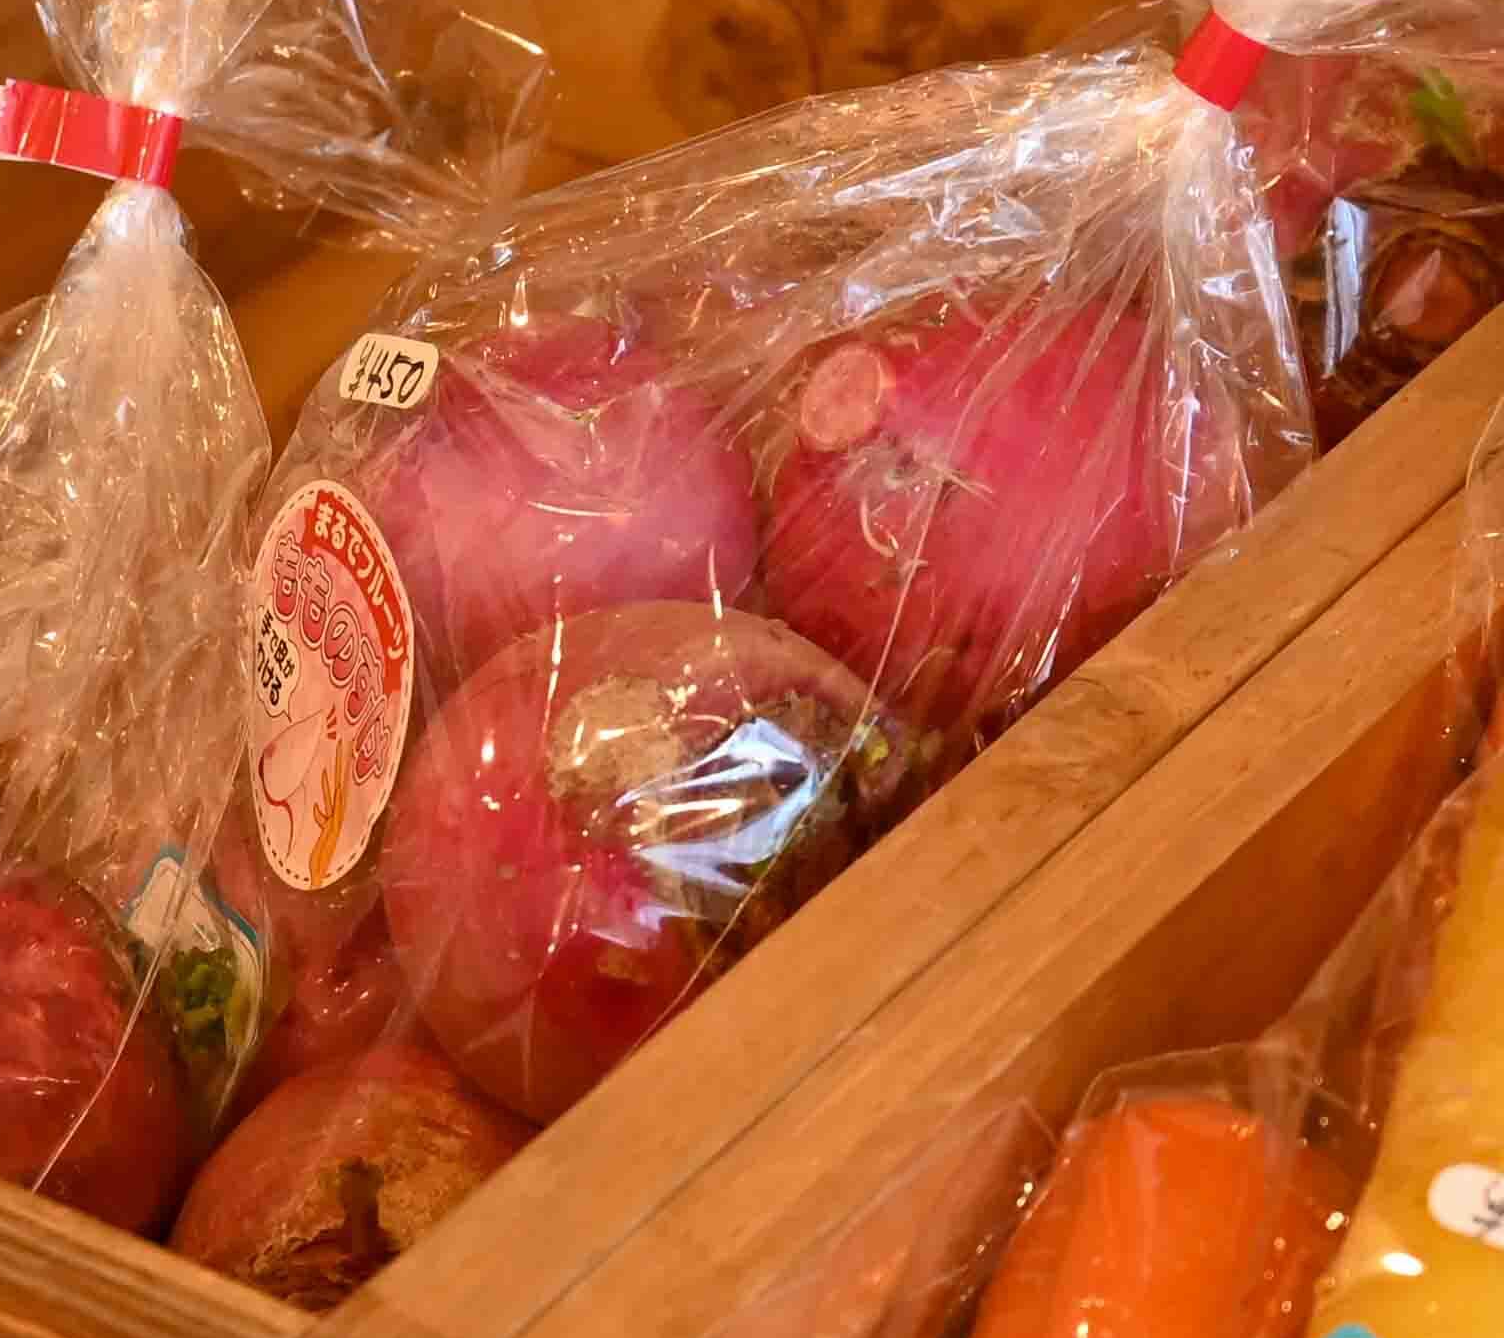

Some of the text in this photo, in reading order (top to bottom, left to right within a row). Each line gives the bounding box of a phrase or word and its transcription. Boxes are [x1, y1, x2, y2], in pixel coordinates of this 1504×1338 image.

[272, 533, 391, 785] もものすけ
[314, 501, 403, 659] まるでフルーツ
